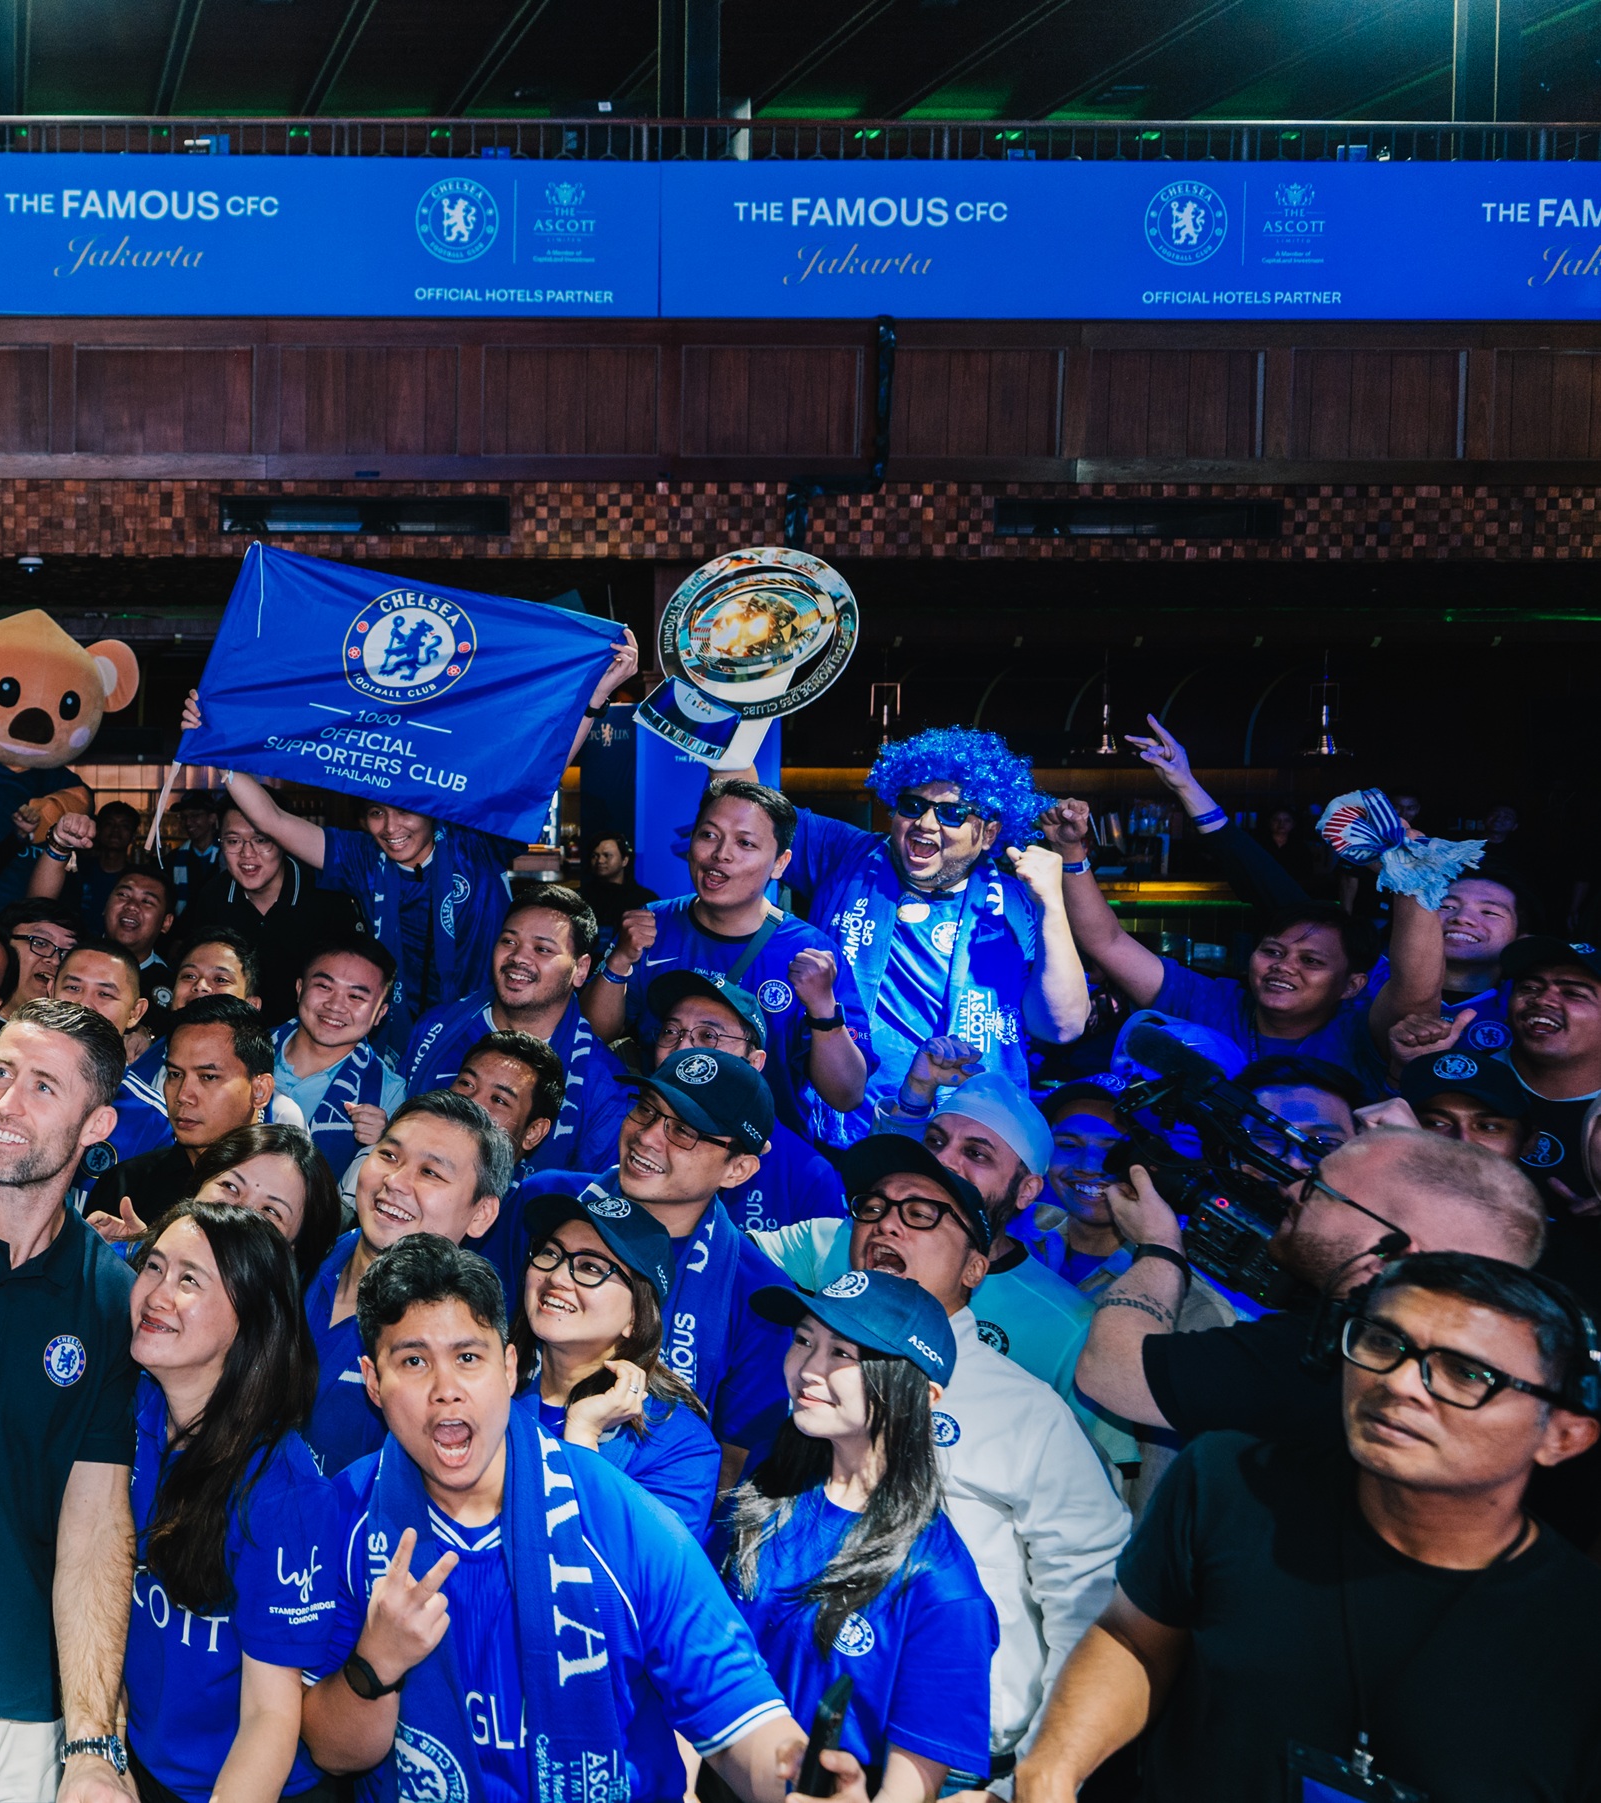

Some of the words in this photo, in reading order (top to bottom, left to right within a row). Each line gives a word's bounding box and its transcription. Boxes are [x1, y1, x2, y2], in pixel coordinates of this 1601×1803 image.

[431, 181, 483, 199] CHELSEA
[1160, 184, 1213, 202] CHELSEA
[5, 193, 55, 214] THE
[62, 190, 219, 220] FAMOUS
[226, 196, 279, 216] CFC
[554, 207, 575, 216] THE
[734, 202, 783, 222] THE
[791, 197, 949, 227] FAMOUS
[955, 202, 1008, 222] CFC
[1284, 208, 1306, 217] THE
[1482, 202, 1530, 223] THE
[1538, 198, 1601, 228] FAM
[533, 219, 596, 232] ASCOTT
[1263, 220, 1326, 233] ASCOTT
[54, 234, 204, 277] Jakarta
[783, 243, 932, 285] Jakarta
[415, 287, 482, 300] OFFICIAL
[486, 289, 543, 302] HOTELS
[546, 290, 613, 304] PARTNER
[1142, 291, 1210, 304] OFFICIAL
[1213, 291, 1271, 304] HOTELS
[1274, 291, 1342, 304] PARTNER
[380, 592, 461, 627] CHELSEA
[664, 607, 682, 655] MUNDIAL
[352, 672, 401, 698] FOOTBALL
[407, 683, 437, 698] CLUB
[355, 709, 402, 726] 1000
[742, 701, 779, 717] CLUBS
[320, 727, 417, 758] OFFICIAL
[263, 736, 403, 775] SUPPORTERS
[409, 763, 468, 793] CLUB
[324, 765, 391, 789] THAILAND
[840, 910, 854, 933] THE
[861, 919, 876, 946] CFC
[694, 967, 709, 977] FINAL
[711, 969, 726, 980] PORT
[393, 981, 403, 1003] CFC
[970, 989, 986, 1053] ASCOTT
[985, 1010, 996, 1033] THE
[671, 1312, 696, 1384] MOUS
[269, 1604, 309, 1617] STAMFORD
[309, 1600, 336, 1613] BRIDGE
[289, 1613, 319, 1625] LONDON
[419, 1739, 449, 1769] CLUB
[570, 1760, 582, 1801] LIMI
[587, 1750, 610, 1803] ASC
